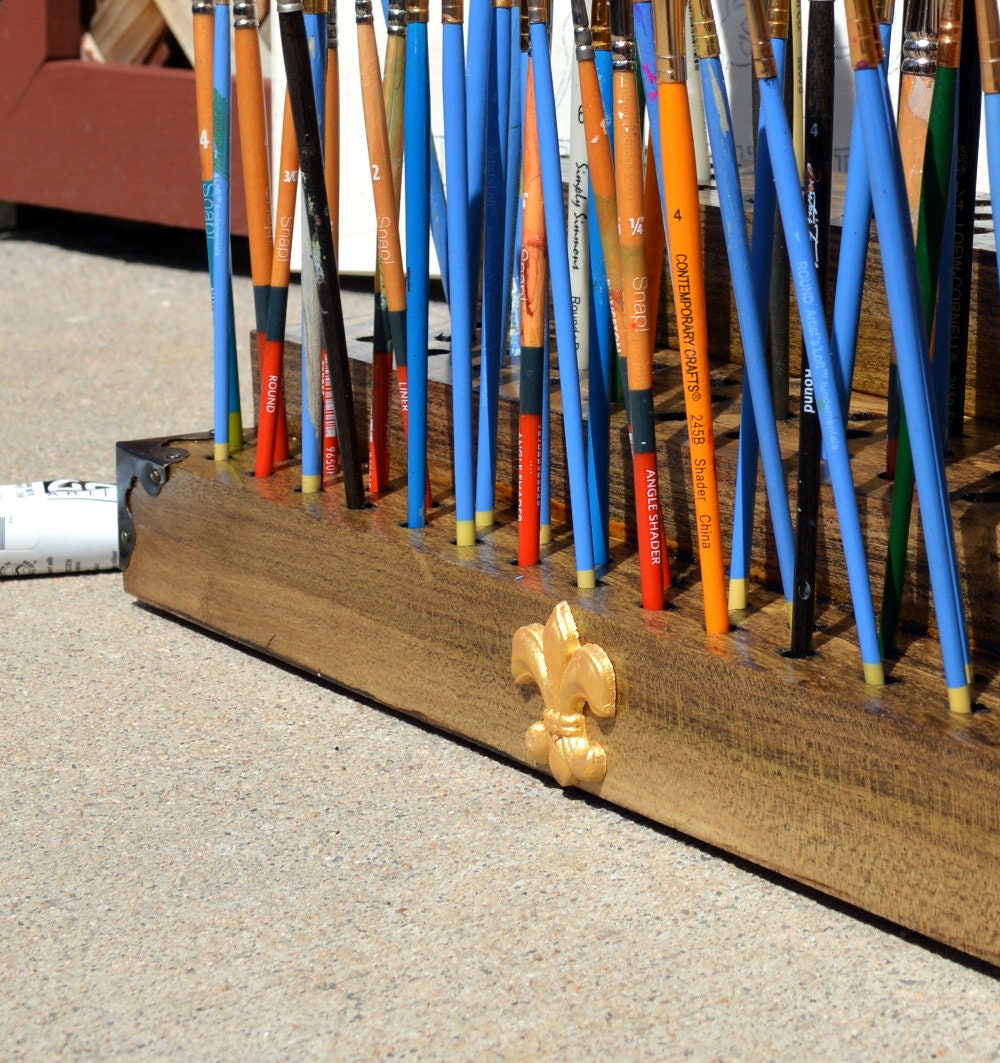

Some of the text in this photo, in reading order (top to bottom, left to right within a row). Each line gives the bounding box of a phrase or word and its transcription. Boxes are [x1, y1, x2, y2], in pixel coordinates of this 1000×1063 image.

[200, 130, 209, 149] 4
[810, 122, 819, 138] 4
[371, 164, 381, 181] 2
[571, 162, 589, 271] Simply Simmons
[673, 209, 682, 222] 4
[675, 254, 695, 347] CONTEMPORARY
[796, 261, 815, 304] ROUND
[632, 276, 650, 333] Snap!
[266, 374, 279, 413] ROUND
[690, 414, 706, 446] 245B
[694, 458, 707, 502] Shader
[645, 469, 661, 566] ANGLE SHADER
[699, 514, 712, 549] China
